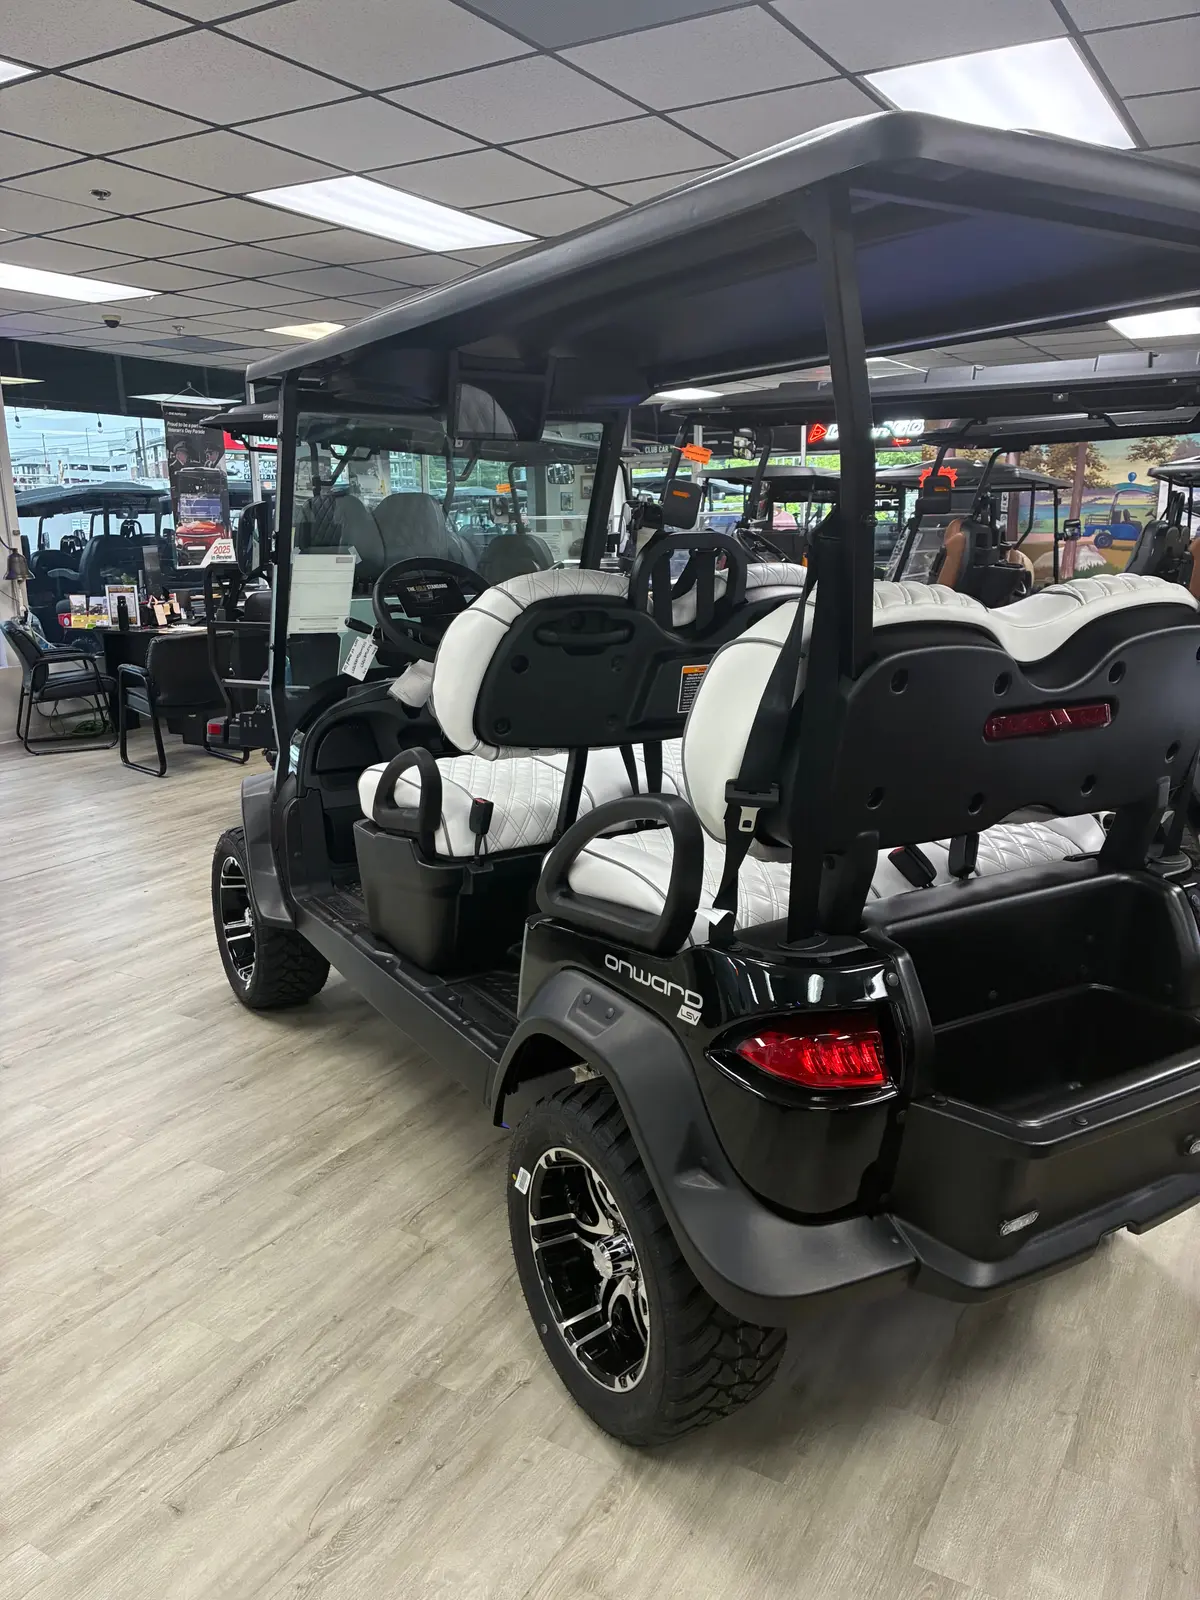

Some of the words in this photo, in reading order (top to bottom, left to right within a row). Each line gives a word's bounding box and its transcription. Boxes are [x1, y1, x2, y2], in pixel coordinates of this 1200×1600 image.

[644, 445, 658, 454] CLUB
[658, 445, 669, 453] CAR
[213, 545, 231, 555] 2025
[680, 1008, 700, 1022] LSV
